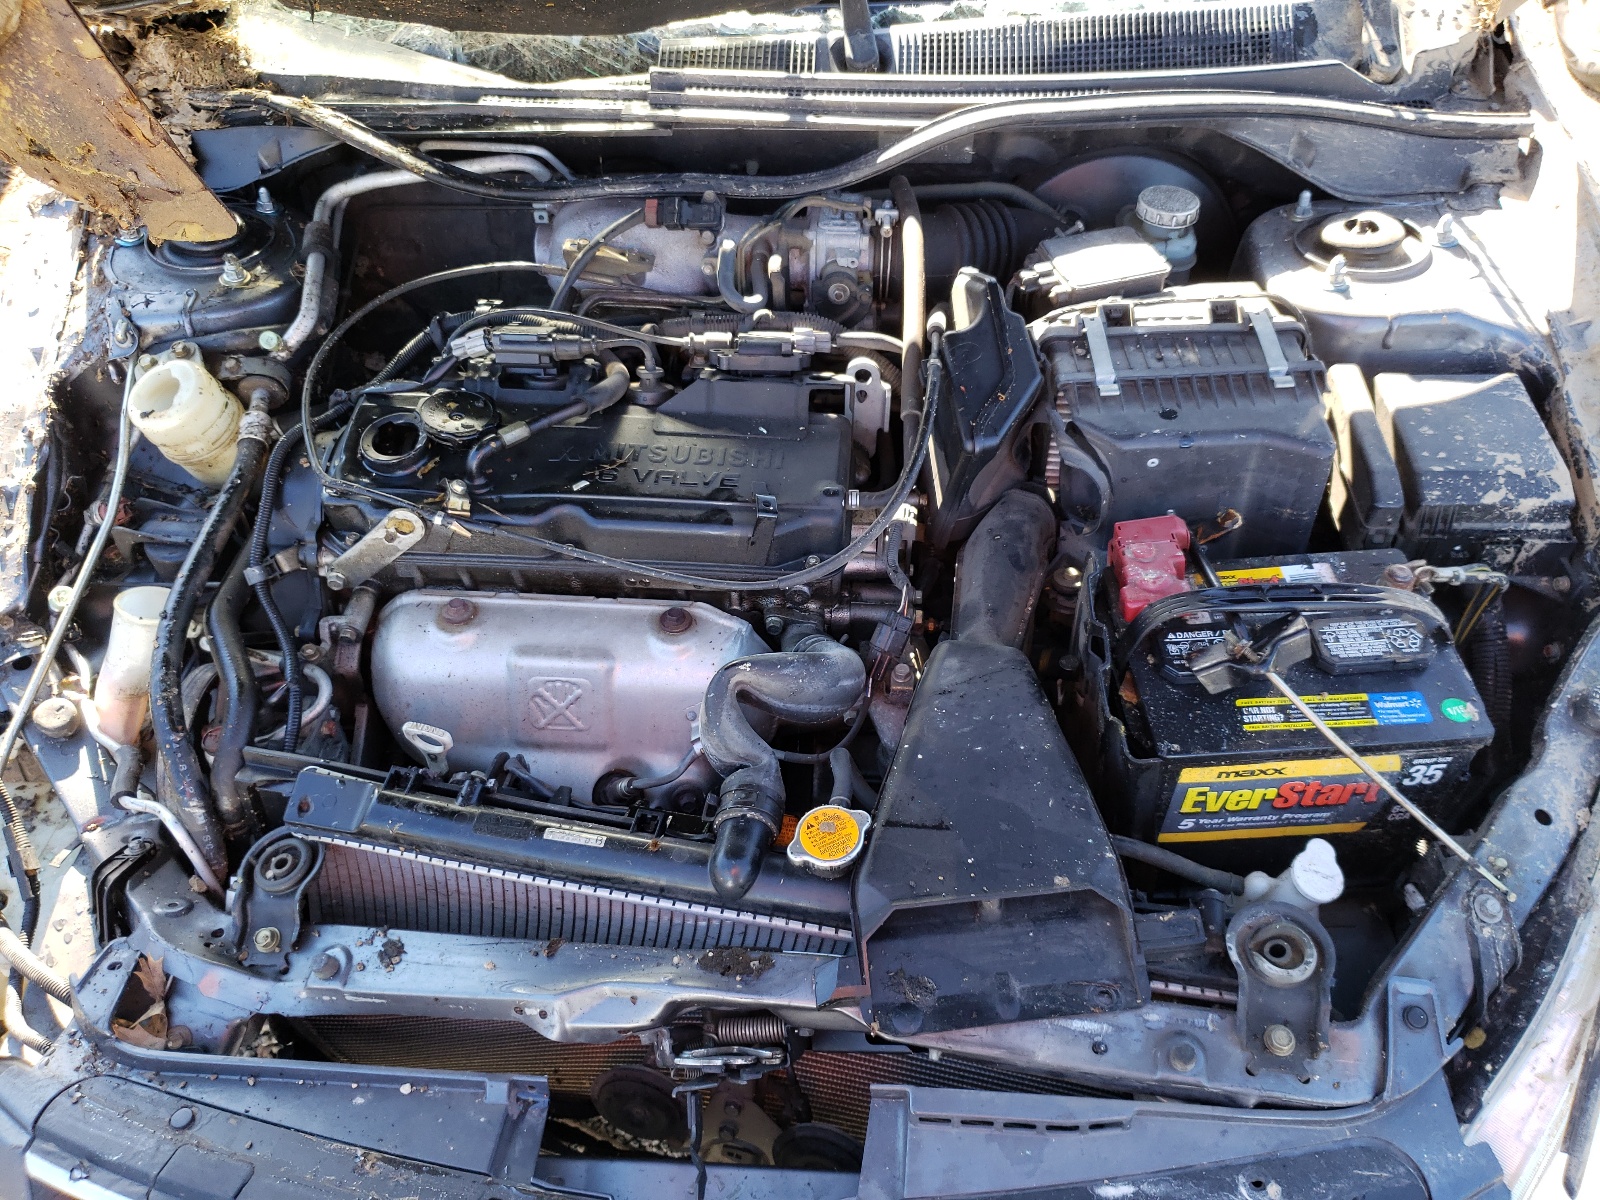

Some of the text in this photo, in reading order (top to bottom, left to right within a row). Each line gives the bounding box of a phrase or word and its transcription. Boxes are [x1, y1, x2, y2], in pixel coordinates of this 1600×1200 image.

[588, 443, 784, 470] MITSUBISHI
[633, 468, 741, 488] VALVE
[1176, 630, 1213, 639] DANGER
[1242, 706, 1276, 714] CAR NOT
[1243, 713, 1285, 722] STARTING?
[1216, 767, 1288, 779] maxx
[1402, 764, 1447, 786] 35
[1180, 780, 1382, 814] EverStart
[1177, 818, 1196, 830] 5
[1198, 817, 1225, 825] Year
[1227, 814, 1279, 822] Warranty
[1387, 812, 1410, 821] CCA
